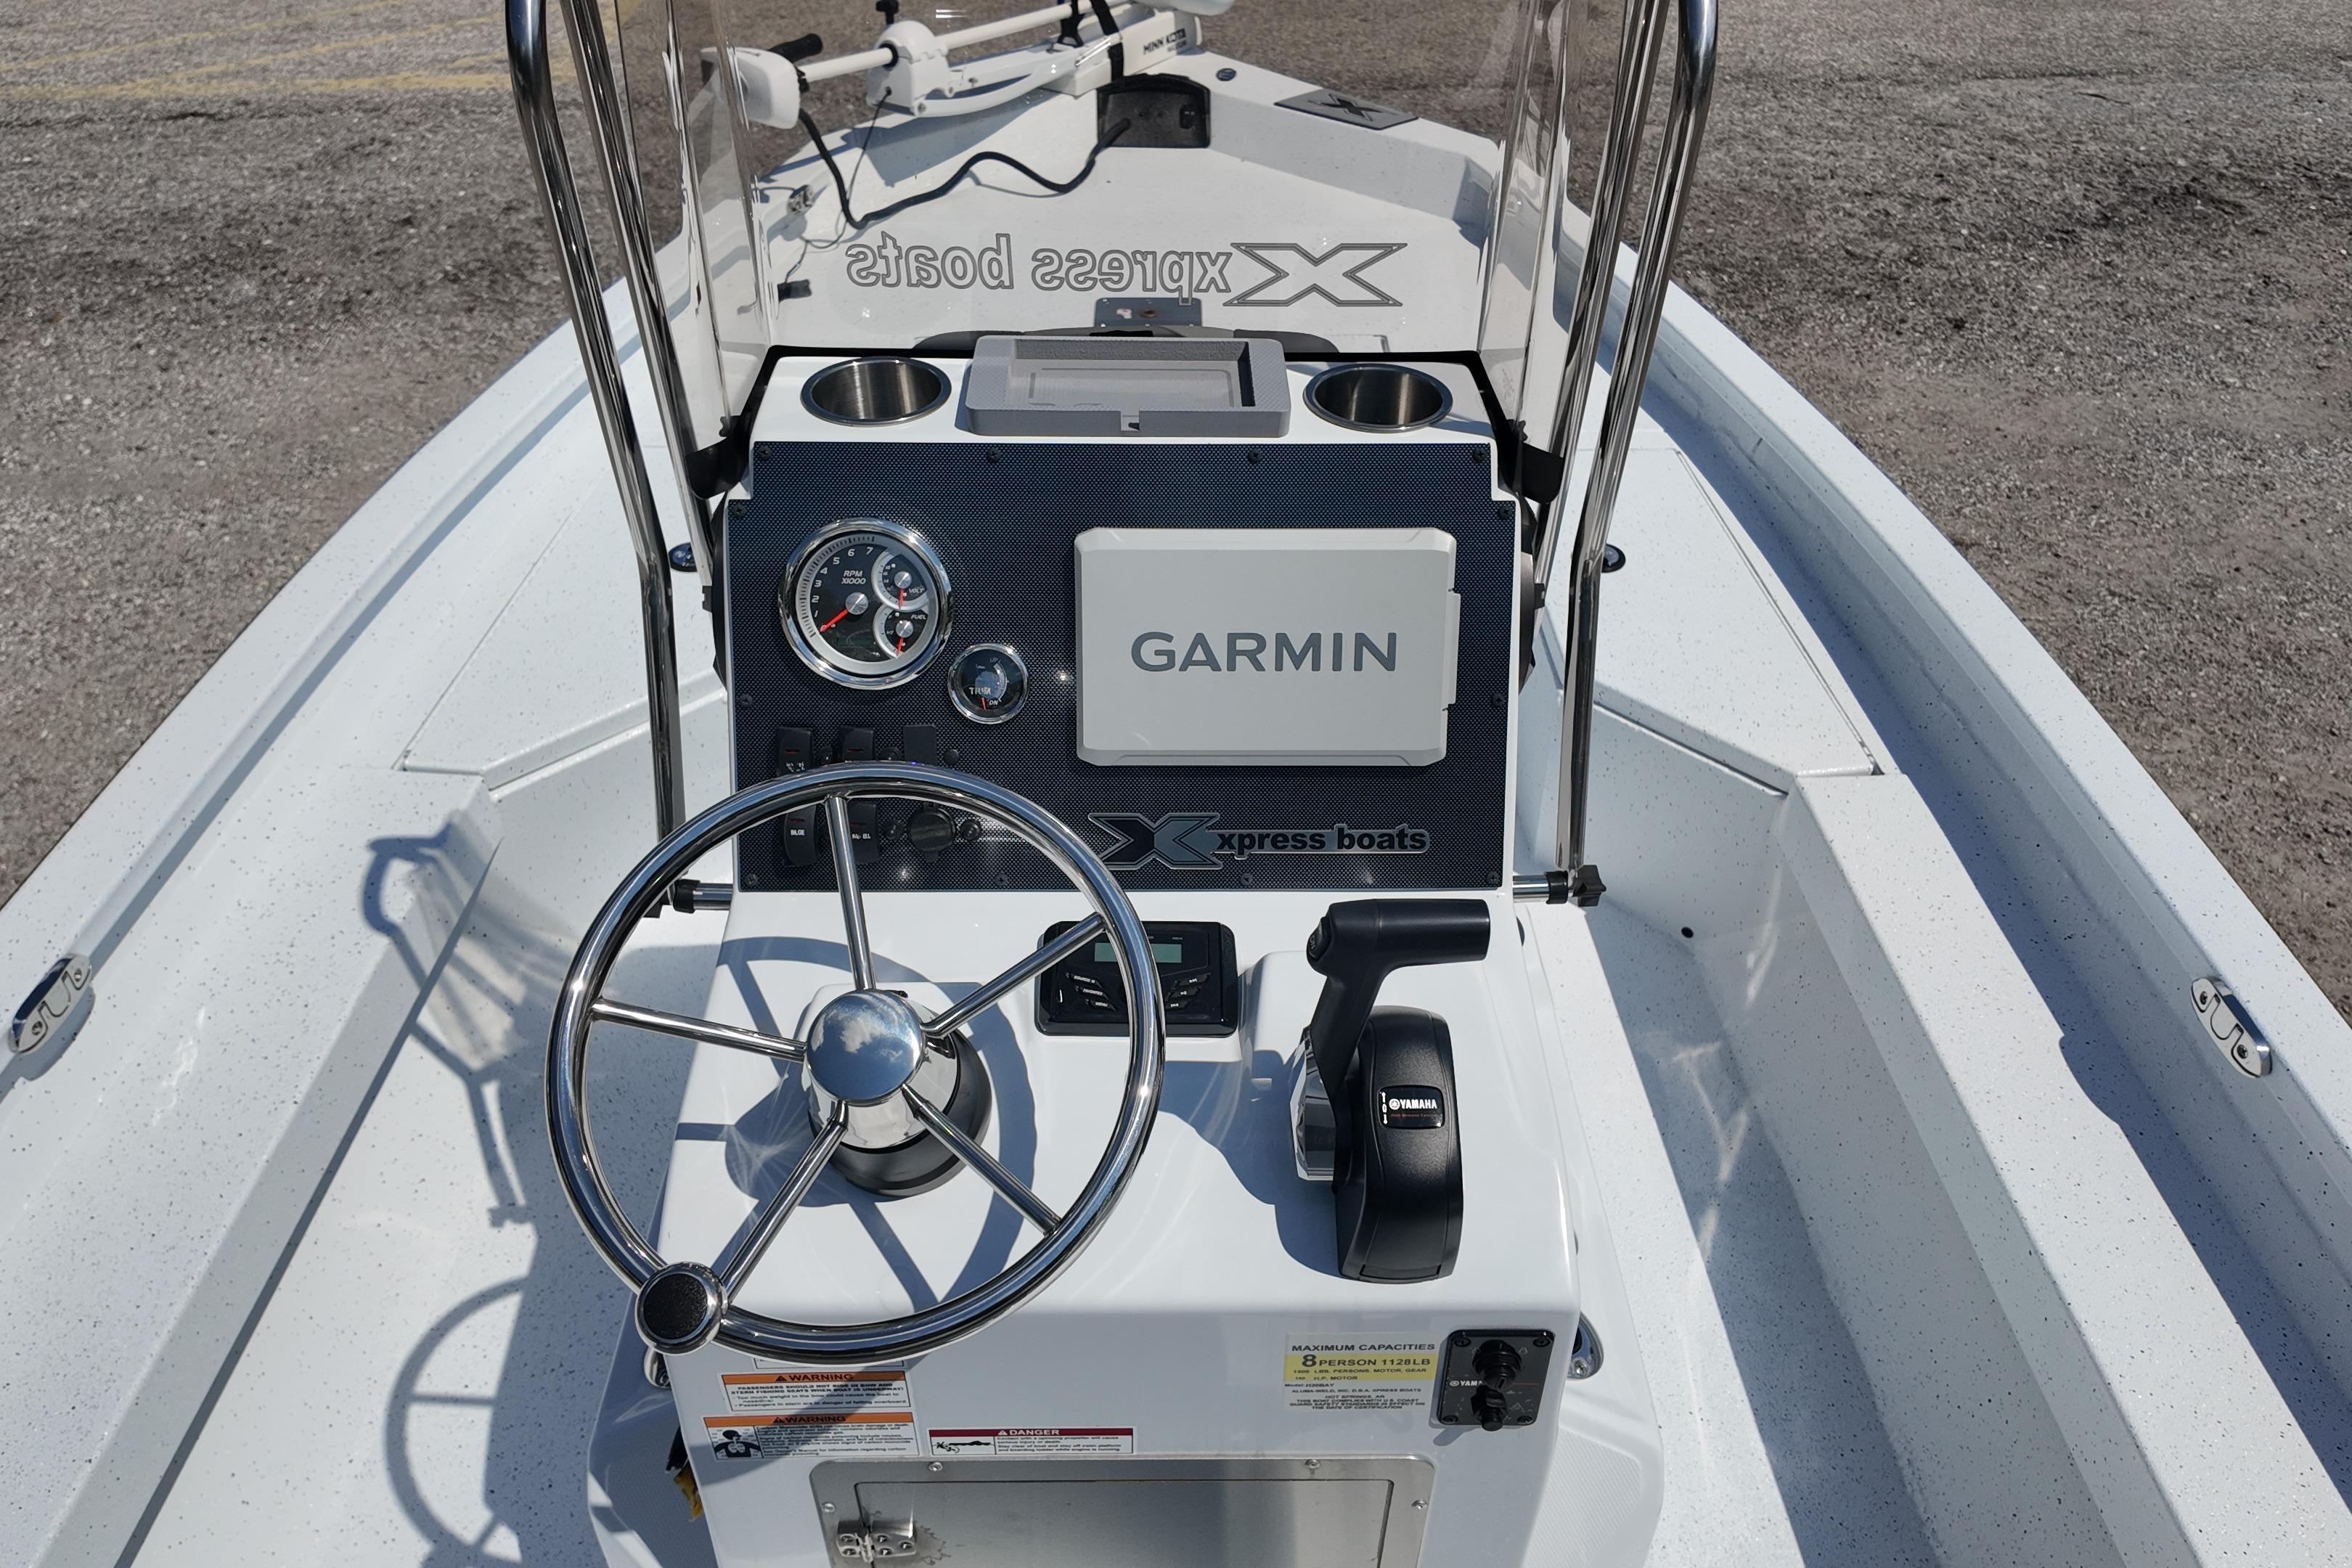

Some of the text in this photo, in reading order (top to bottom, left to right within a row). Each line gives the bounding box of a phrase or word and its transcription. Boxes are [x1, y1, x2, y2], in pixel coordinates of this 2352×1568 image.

[866, 547, 873, 555] 7
[1131, 631, 1397, 672] GARMIN
[1217, 832, 1326, 857] xpress
[1336, 825, 1426, 850] boats
[1400, 1098, 1437, 1109] YAMAHA
